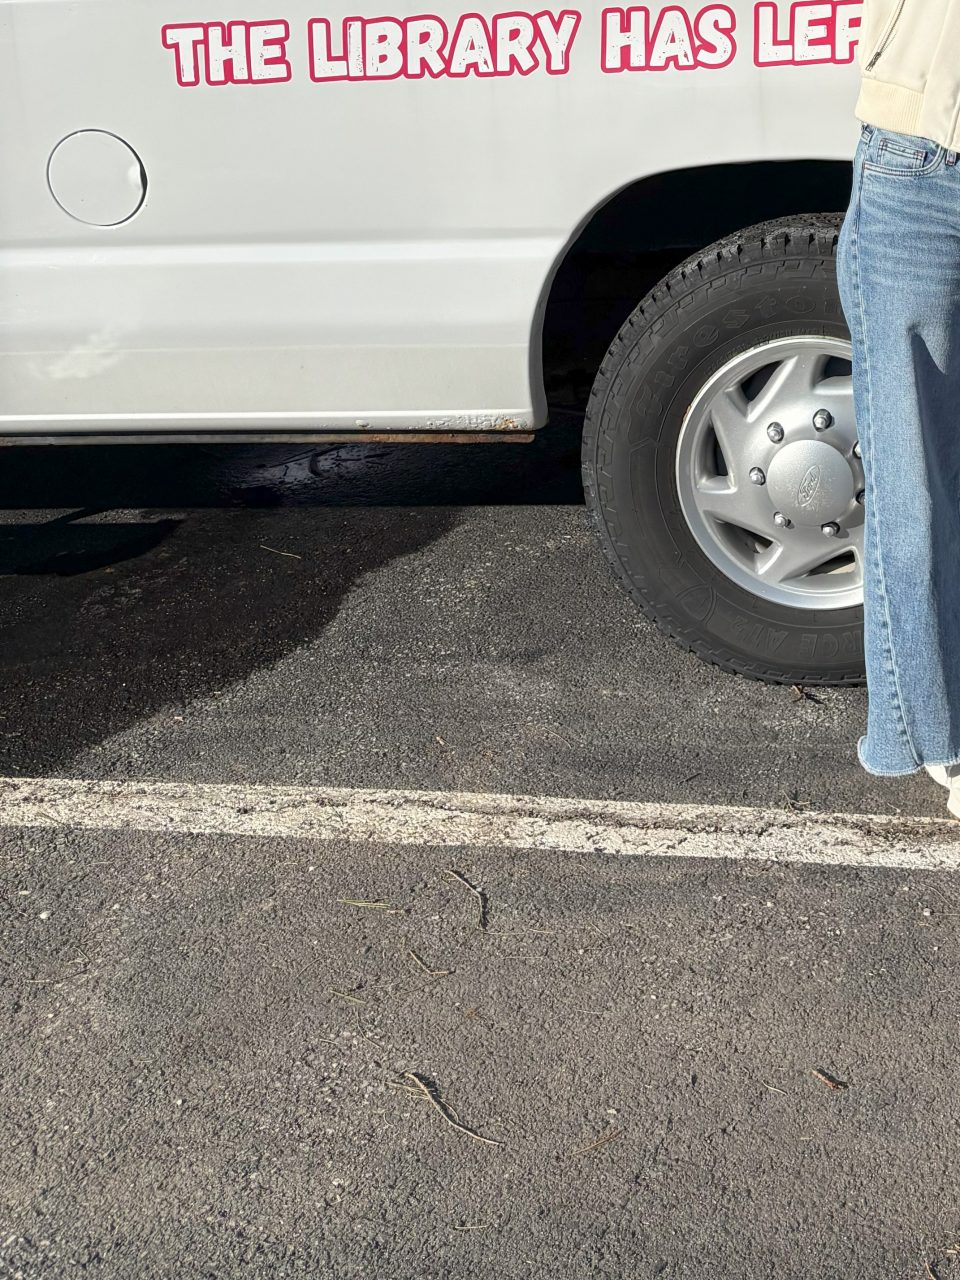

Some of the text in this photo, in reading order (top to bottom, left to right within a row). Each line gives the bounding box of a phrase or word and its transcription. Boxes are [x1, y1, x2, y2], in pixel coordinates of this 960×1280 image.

[162, 20, 292, 87] THE
[308, 10, 581, 83] LIBRARY
[600, 2, 736, 75] HAS
